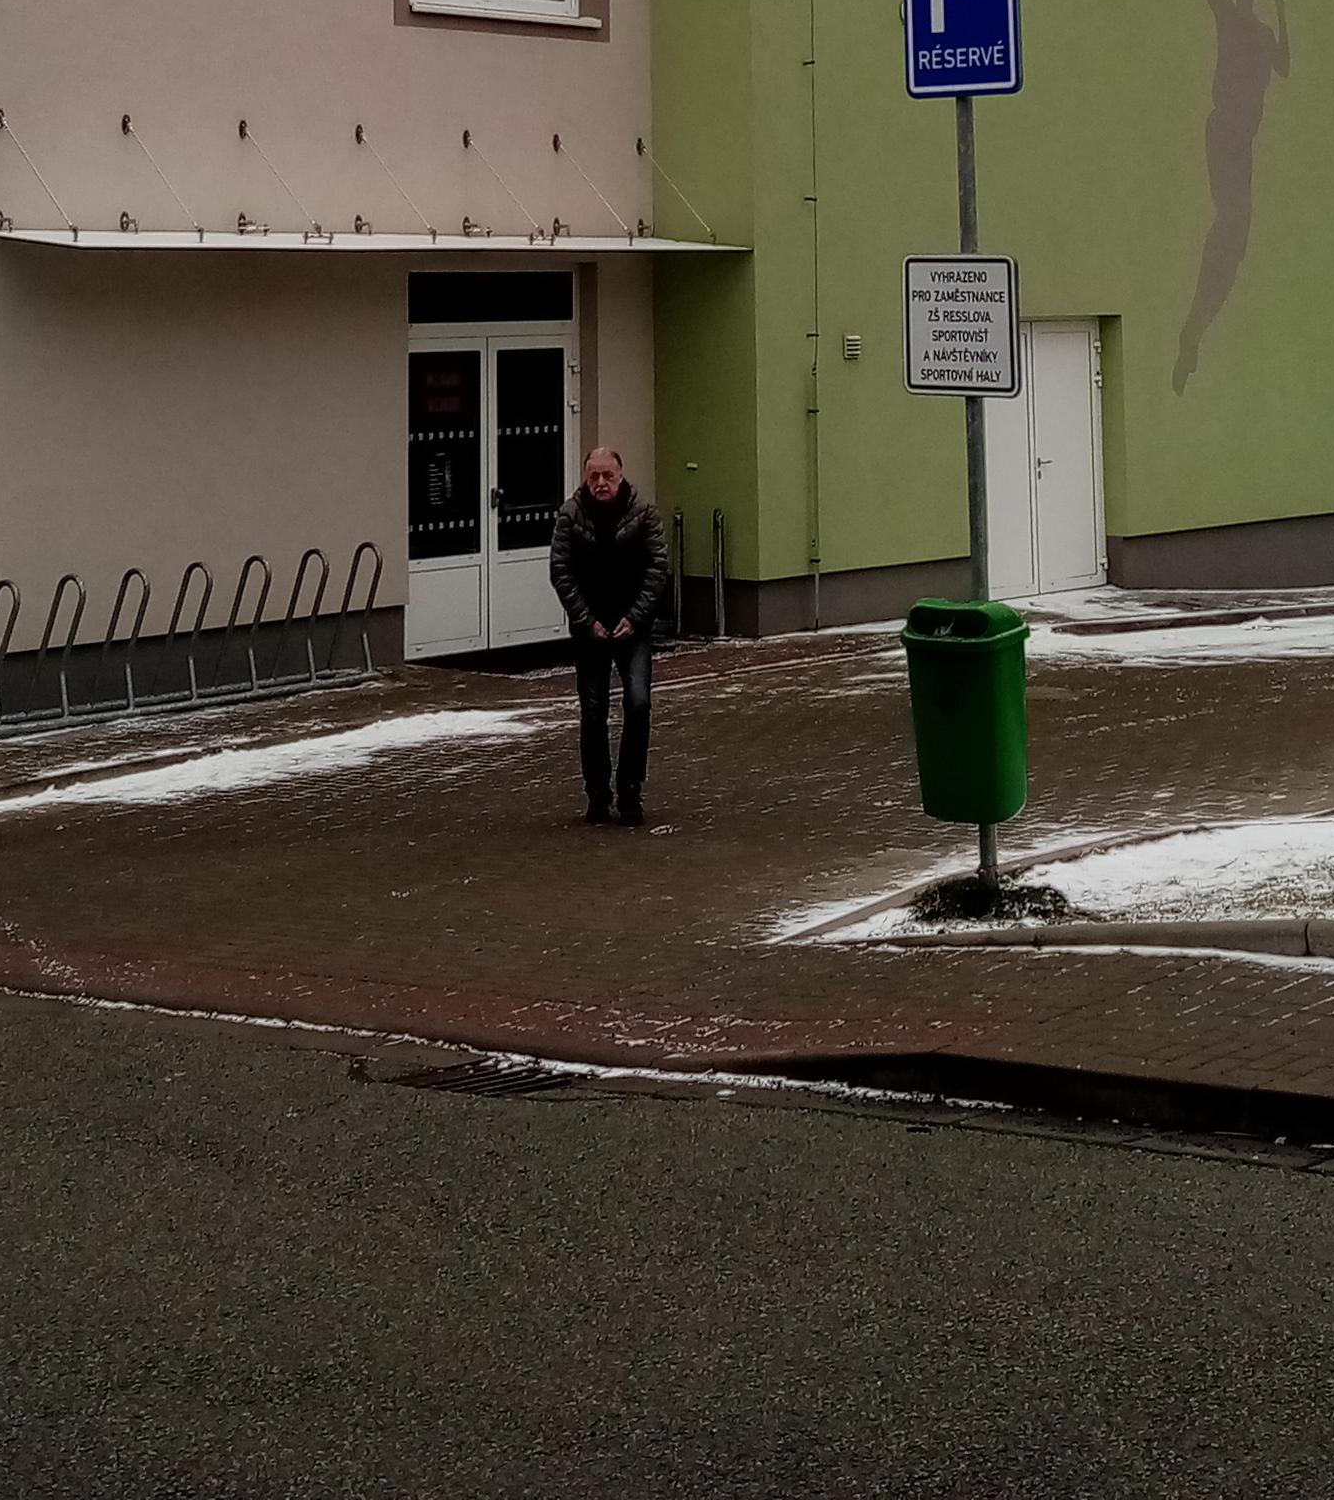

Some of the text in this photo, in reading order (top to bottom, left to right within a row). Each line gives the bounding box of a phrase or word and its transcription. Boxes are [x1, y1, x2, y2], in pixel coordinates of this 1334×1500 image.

[918, 40, 1005, 70] RÉSERVÉ
[930, 271, 987, 283] VYHRAZENO
[912, 288, 1005, 303] PRO ZAMĚSTNANCE
[927, 307, 940, 322] ZŠ
[923, 348, 998, 363] A NÁVŠTĚVNÍKY
[920, 367, 1002, 382] SPORTOVNÍ HALY
